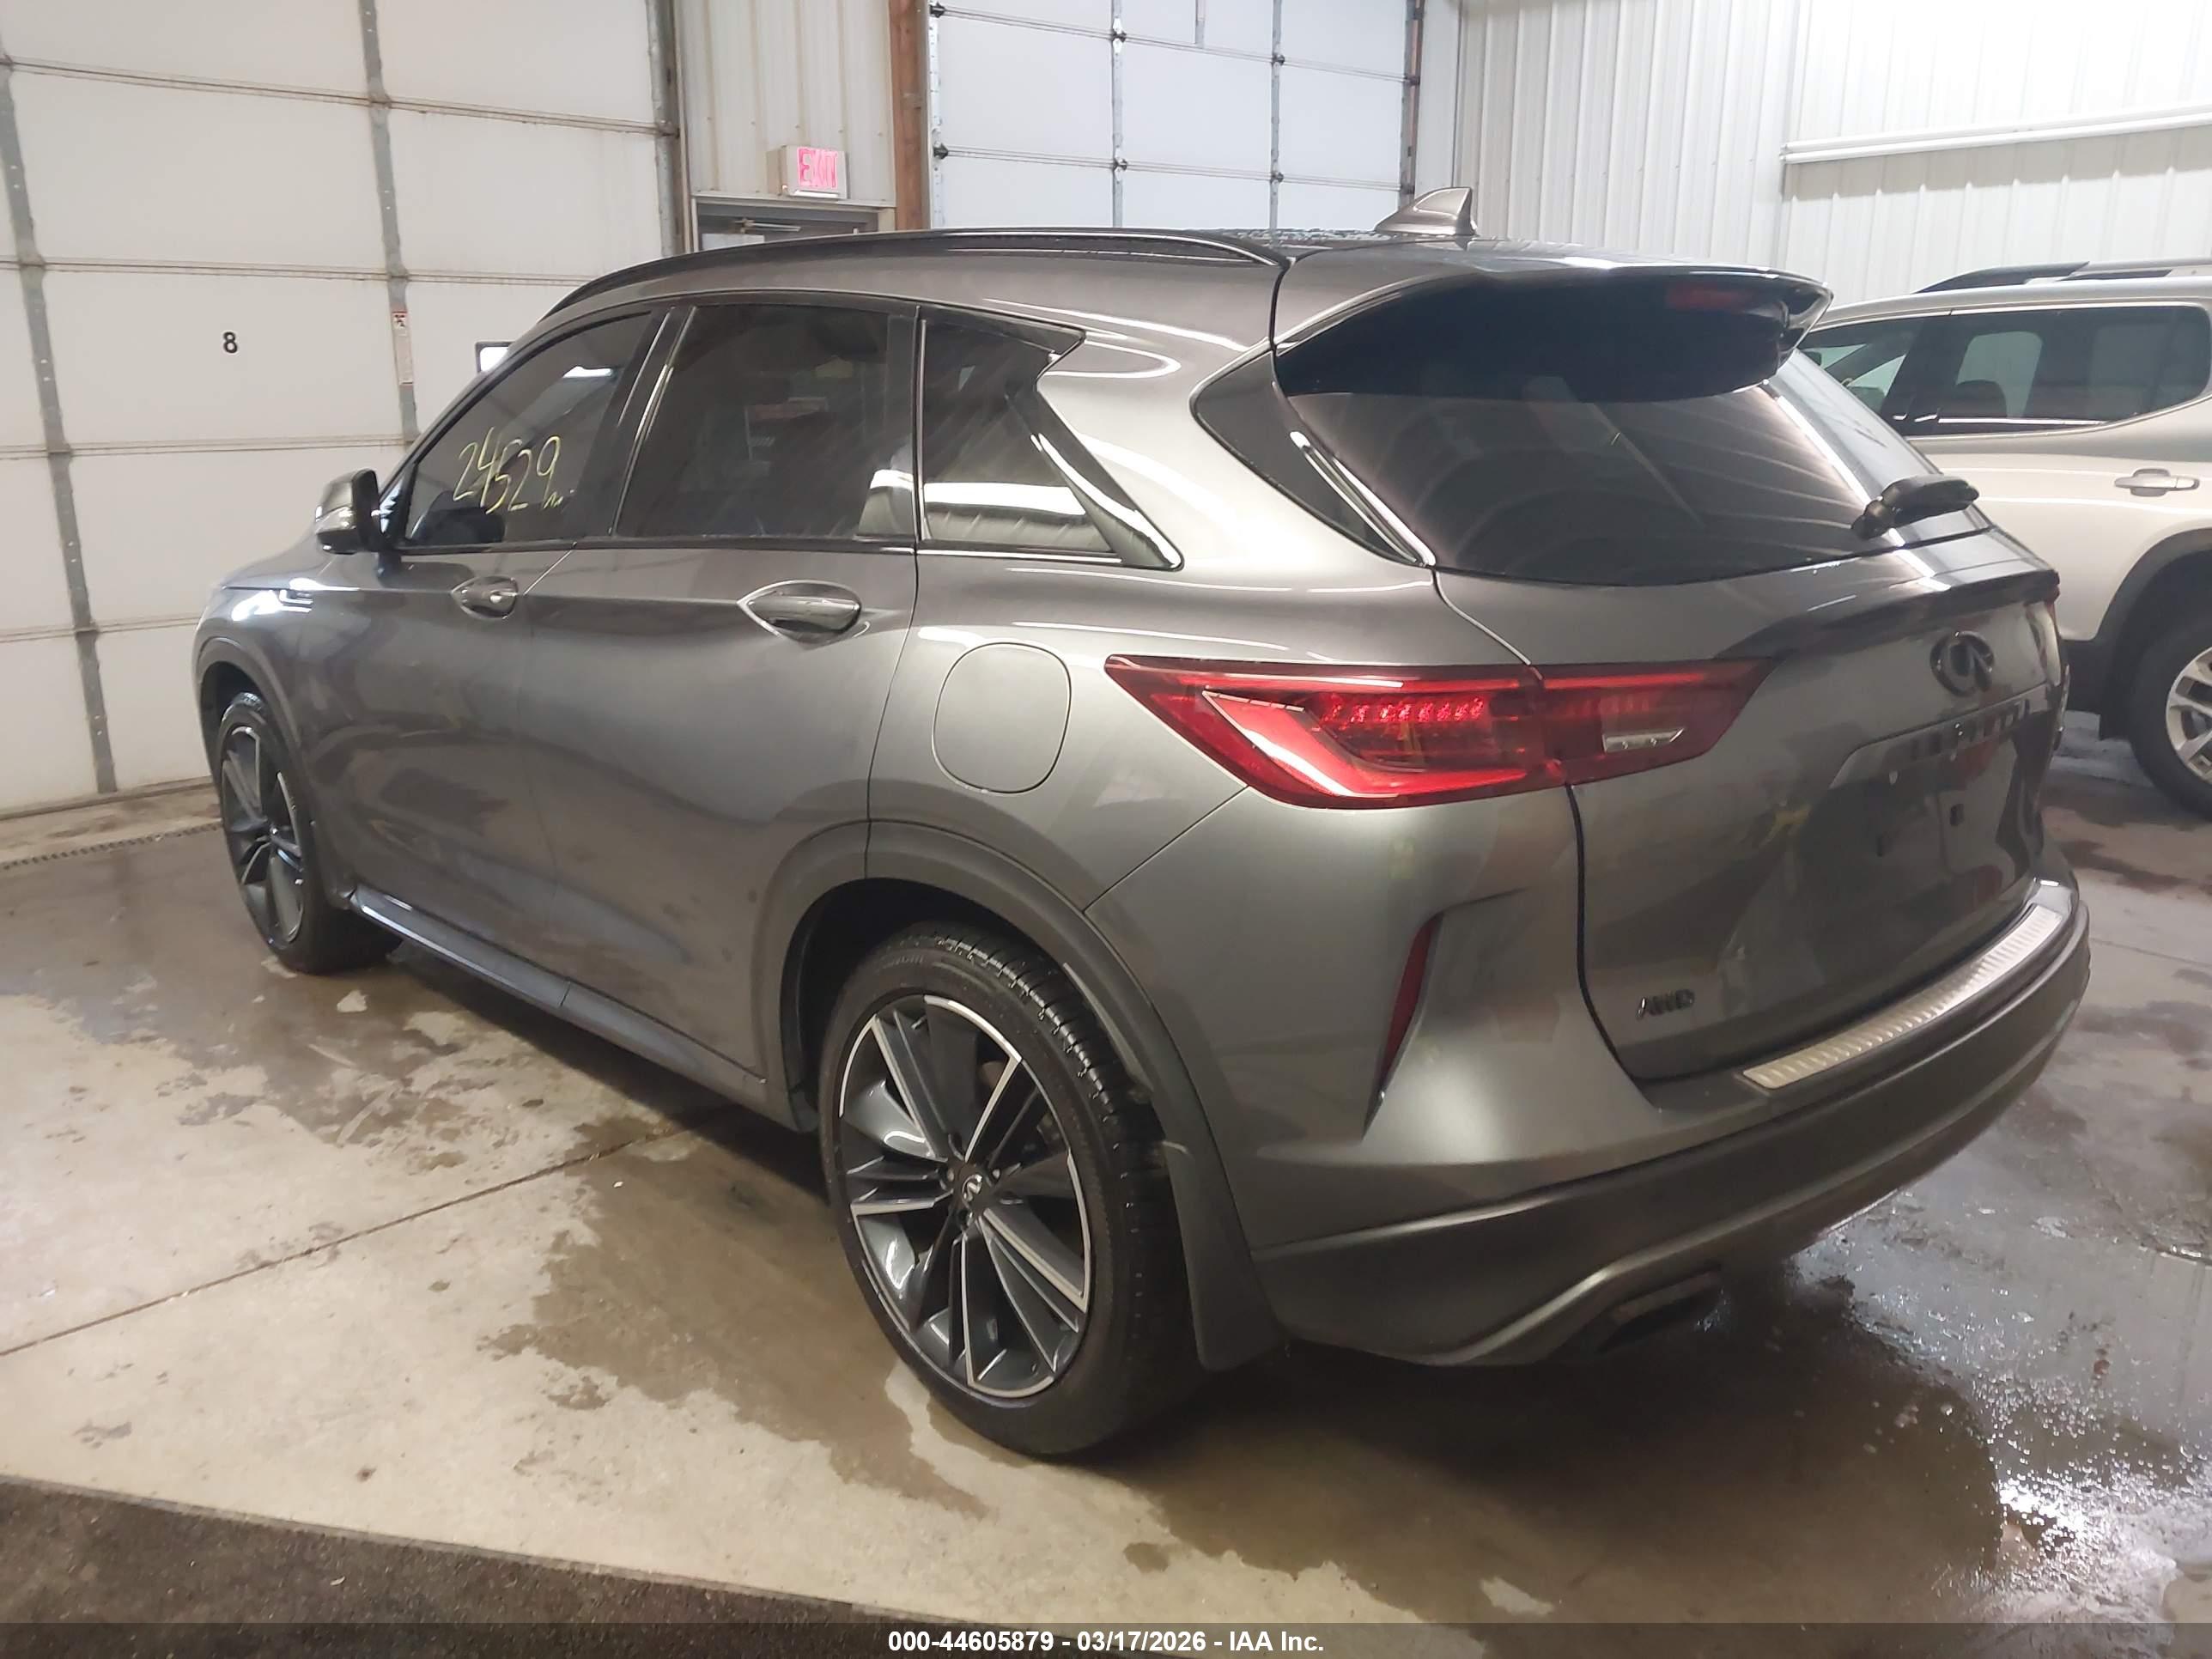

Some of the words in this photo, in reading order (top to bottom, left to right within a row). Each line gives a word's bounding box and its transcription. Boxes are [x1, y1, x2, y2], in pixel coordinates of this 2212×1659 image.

[799, 147, 838, 189] EXIT
[222, 331, 239, 355] 8
[453, 426, 562, 515] 24529
